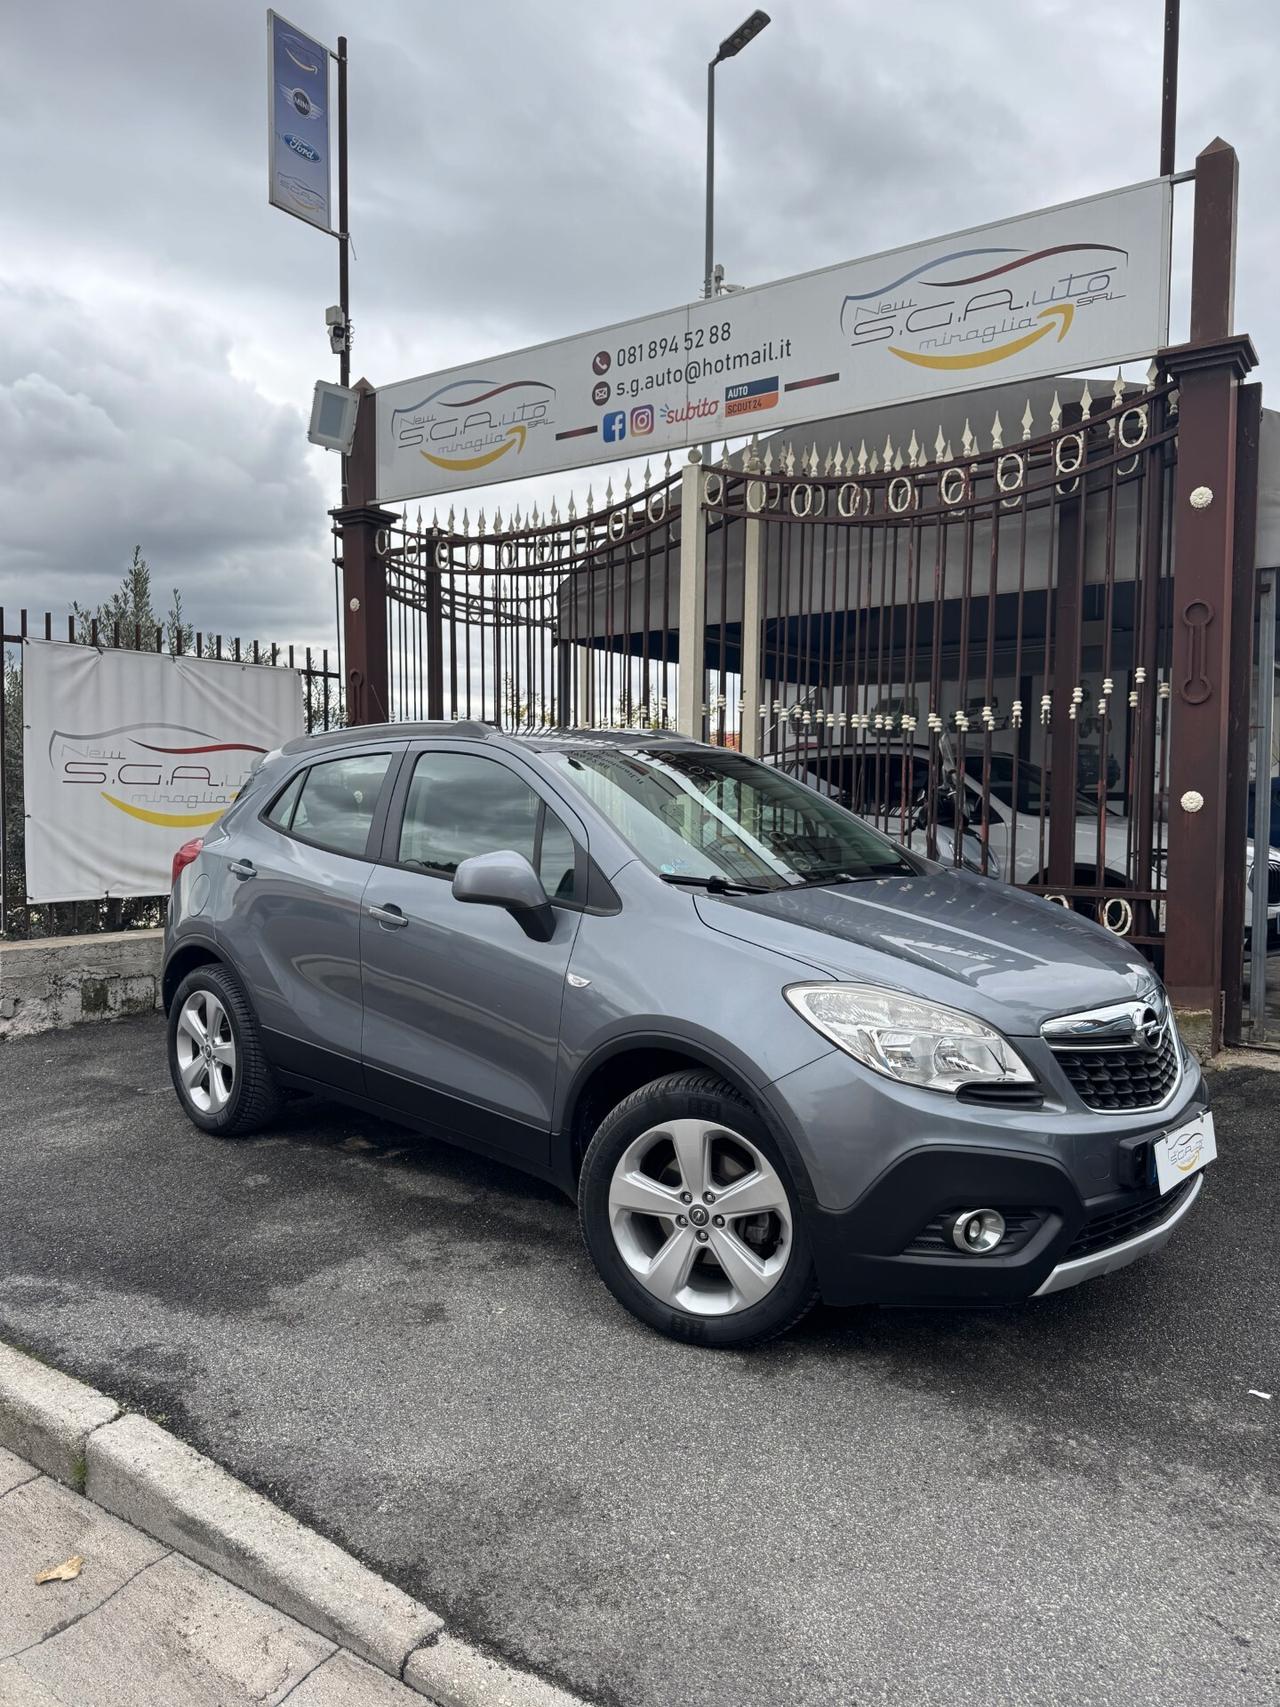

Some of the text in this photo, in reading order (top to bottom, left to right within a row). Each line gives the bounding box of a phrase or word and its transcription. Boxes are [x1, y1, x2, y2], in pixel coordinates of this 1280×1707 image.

[290, 136, 314, 160] Ford
[854, 298, 918, 321] New
[617, 321, 732, 368] 081 894 52 88
[919, 315, 1038, 351] miraglia
[616, 338, 792, 398] s.g.auto@hotmail.it
[727, 385, 749, 400] AUTO
[400, 414, 437, 426] New
[666, 396, 720, 426] subito
[61, 743, 127, 760] New
[130, 792, 231, 809] miraglia
